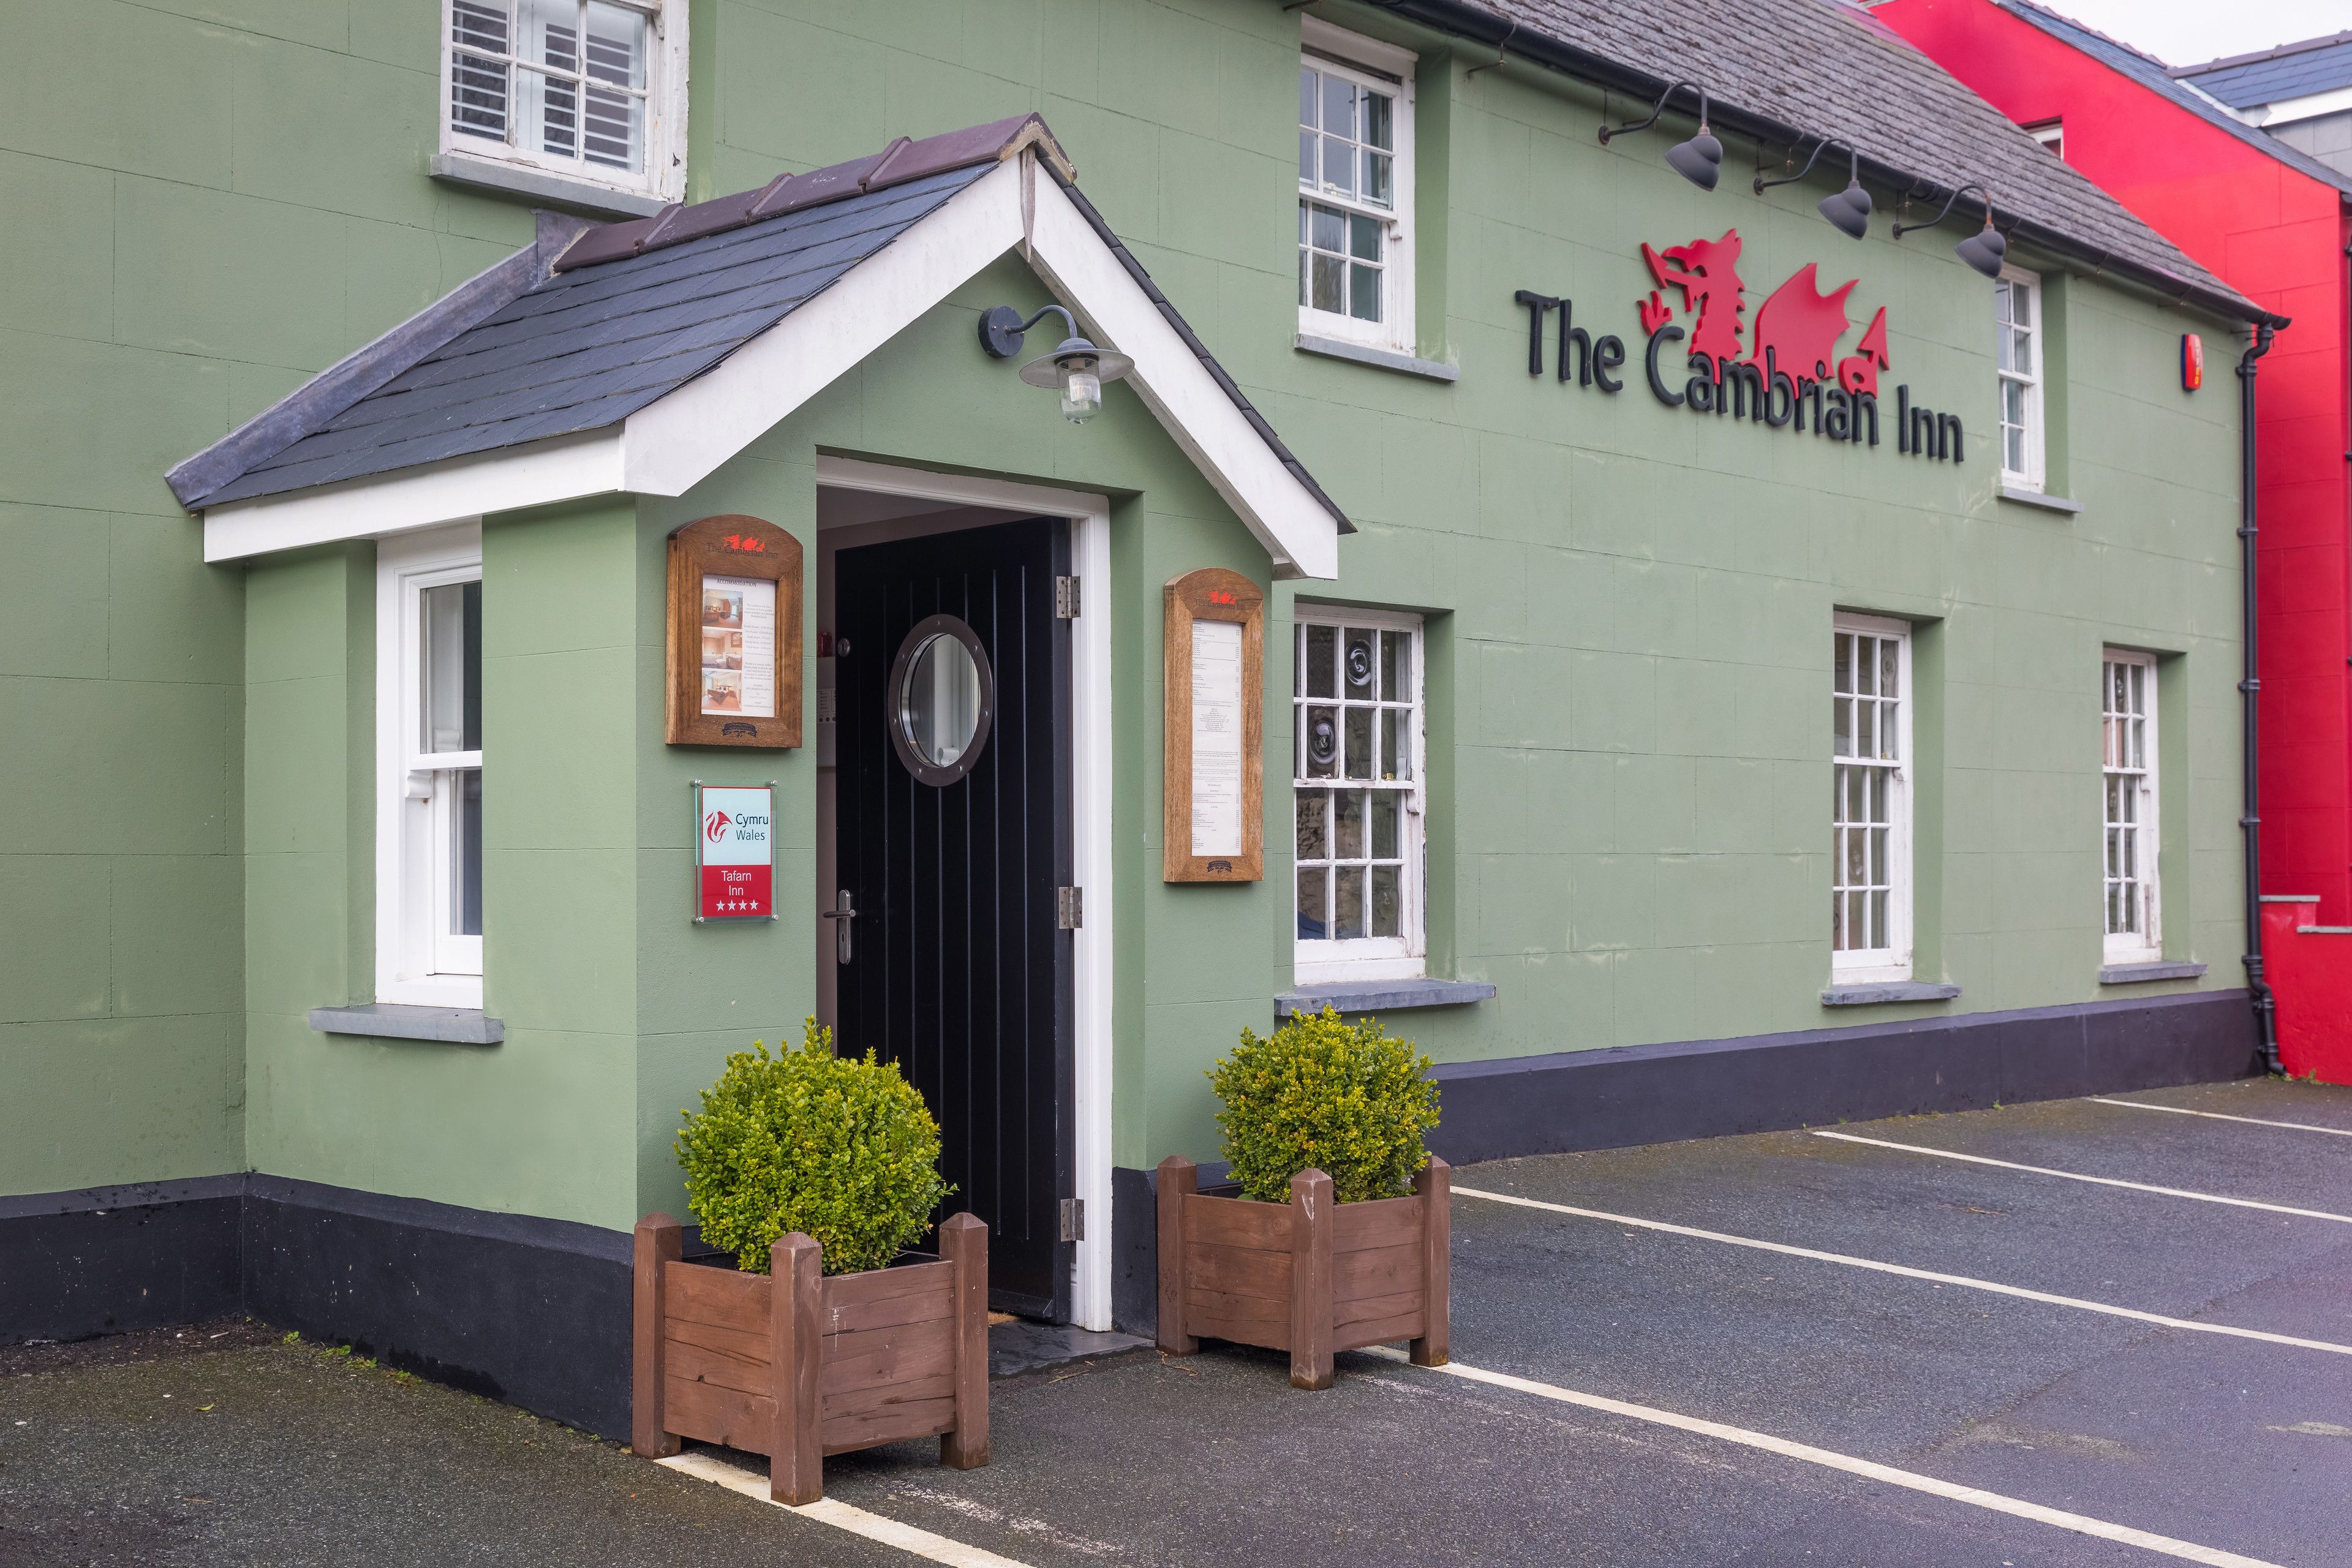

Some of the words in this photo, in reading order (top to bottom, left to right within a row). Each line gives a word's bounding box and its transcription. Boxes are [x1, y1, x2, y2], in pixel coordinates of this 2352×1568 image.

[1515, 289, 1625, 392] The
[1645, 325, 1880, 447] Cambrian
[1897, 384, 1964, 462] Inn
[706, 543, 722, 553] The
[724, 545, 763, 557] Cambrian
[766, 549, 778, 559] Inn
[1195, 598, 1205, 606] The
[736, 813, 769, 827] Cymru
[736, 829, 765, 841] Wales
[721, 870, 752, 881] Tafarn
[729, 885, 744, 895] Inn
